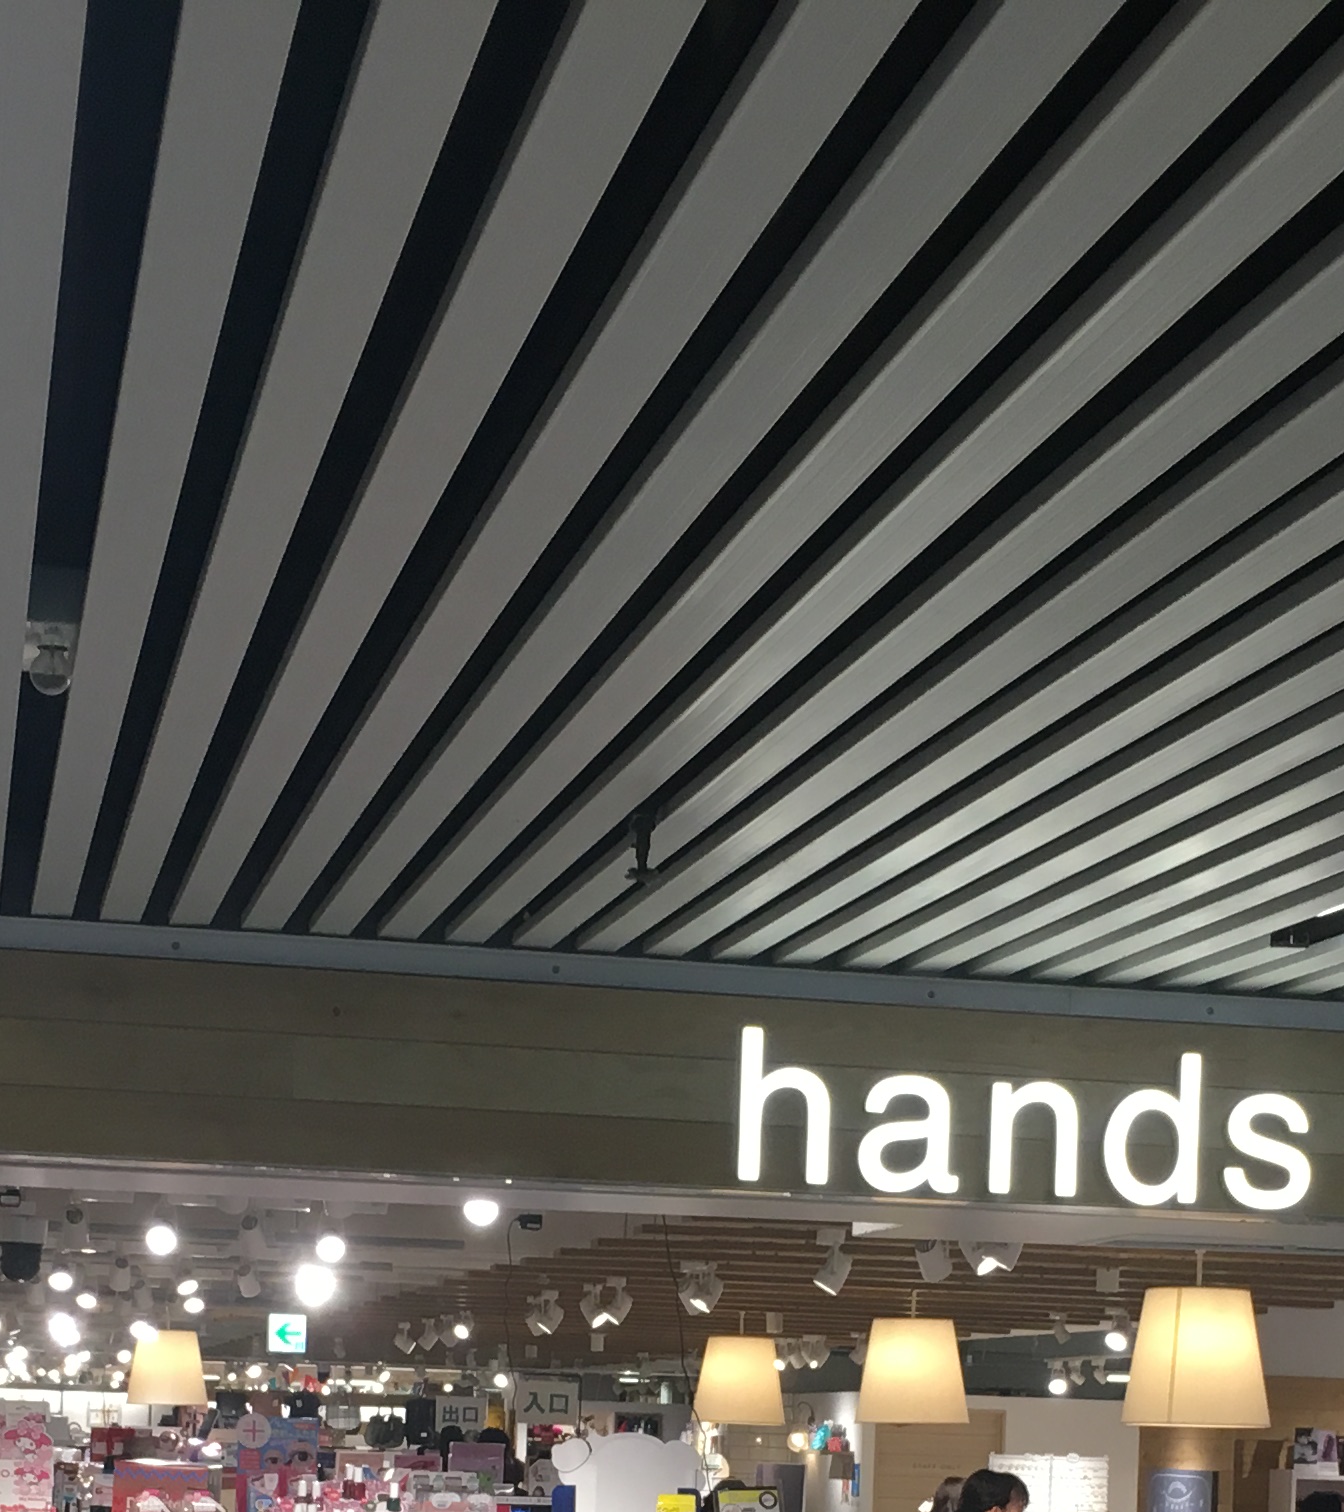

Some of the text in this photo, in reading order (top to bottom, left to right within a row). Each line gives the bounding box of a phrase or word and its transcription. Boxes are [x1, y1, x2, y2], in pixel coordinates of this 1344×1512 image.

[737, 1026, 1311, 1211] hands
[442, 1405, 479, 1424] 出口
[523, 1391, 569, 1415] 入口
